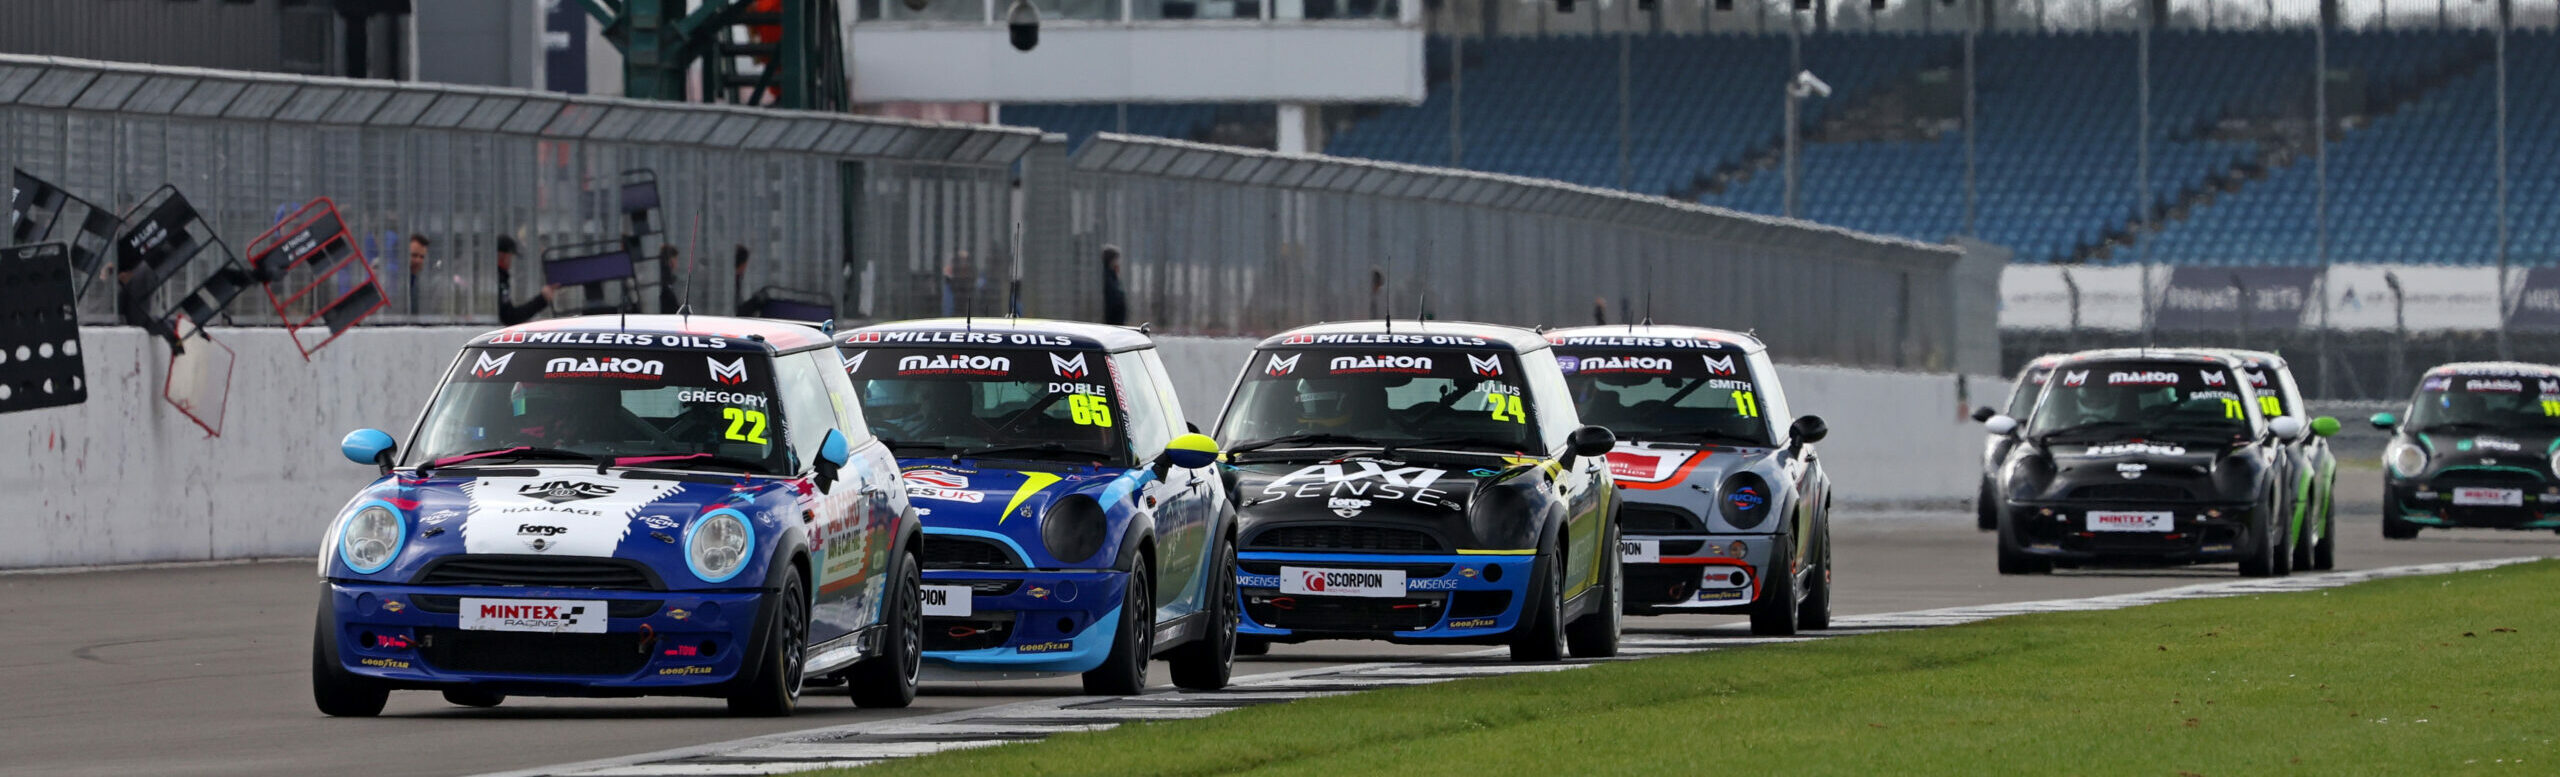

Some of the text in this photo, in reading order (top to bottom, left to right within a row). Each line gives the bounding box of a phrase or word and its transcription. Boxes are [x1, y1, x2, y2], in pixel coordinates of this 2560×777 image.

[529, 332, 727, 349] MILLERS OILS
[884, 331, 1072, 346] MILLERS OILS
[1317, 334, 1486, 346] MILLERS OILS
[1568, 337, 1722, 349] MILLERS OILS
[1049, 383, 1106, 396] DOBLE
[1475, 380, 1521, 396] JULIUS
[1710, 379, 1752, 391] SMITH
[678, 390, 768, 407] GREGORY
[1731, 390, 1758, 417] 11
[1068, 394, 1112, 428] 65
[1488, 393, 1526, 424] 24
[2221, 398, 2244, 420] 71
[723, 407, 768, 445] 22
[1266, 461, 1448, 488] AXI
[518, 480, 619, 496] HMS
[1257, 480, 1448, 506] SENSE
[1728, 493, 1763, 504] FUCHS
[502, 506, 602, 516] HAULAGE
[638, 515, 680, 529] FUCHS
[1327, 572, 1383, 588] SCORPION
[1409, 578, 1458, 589] AXISENSE
[481, 605, 559, 619] MINTEX
[1450, 618, 1495, 628] GOODYEAR
[678, 645, 697, 656] TOW
[1020, 641, 1070, 652] GOODYEAR
[362, 658, 409, 668] GOODYEAR
[659, 666, 712, 676] GOODYEAR
